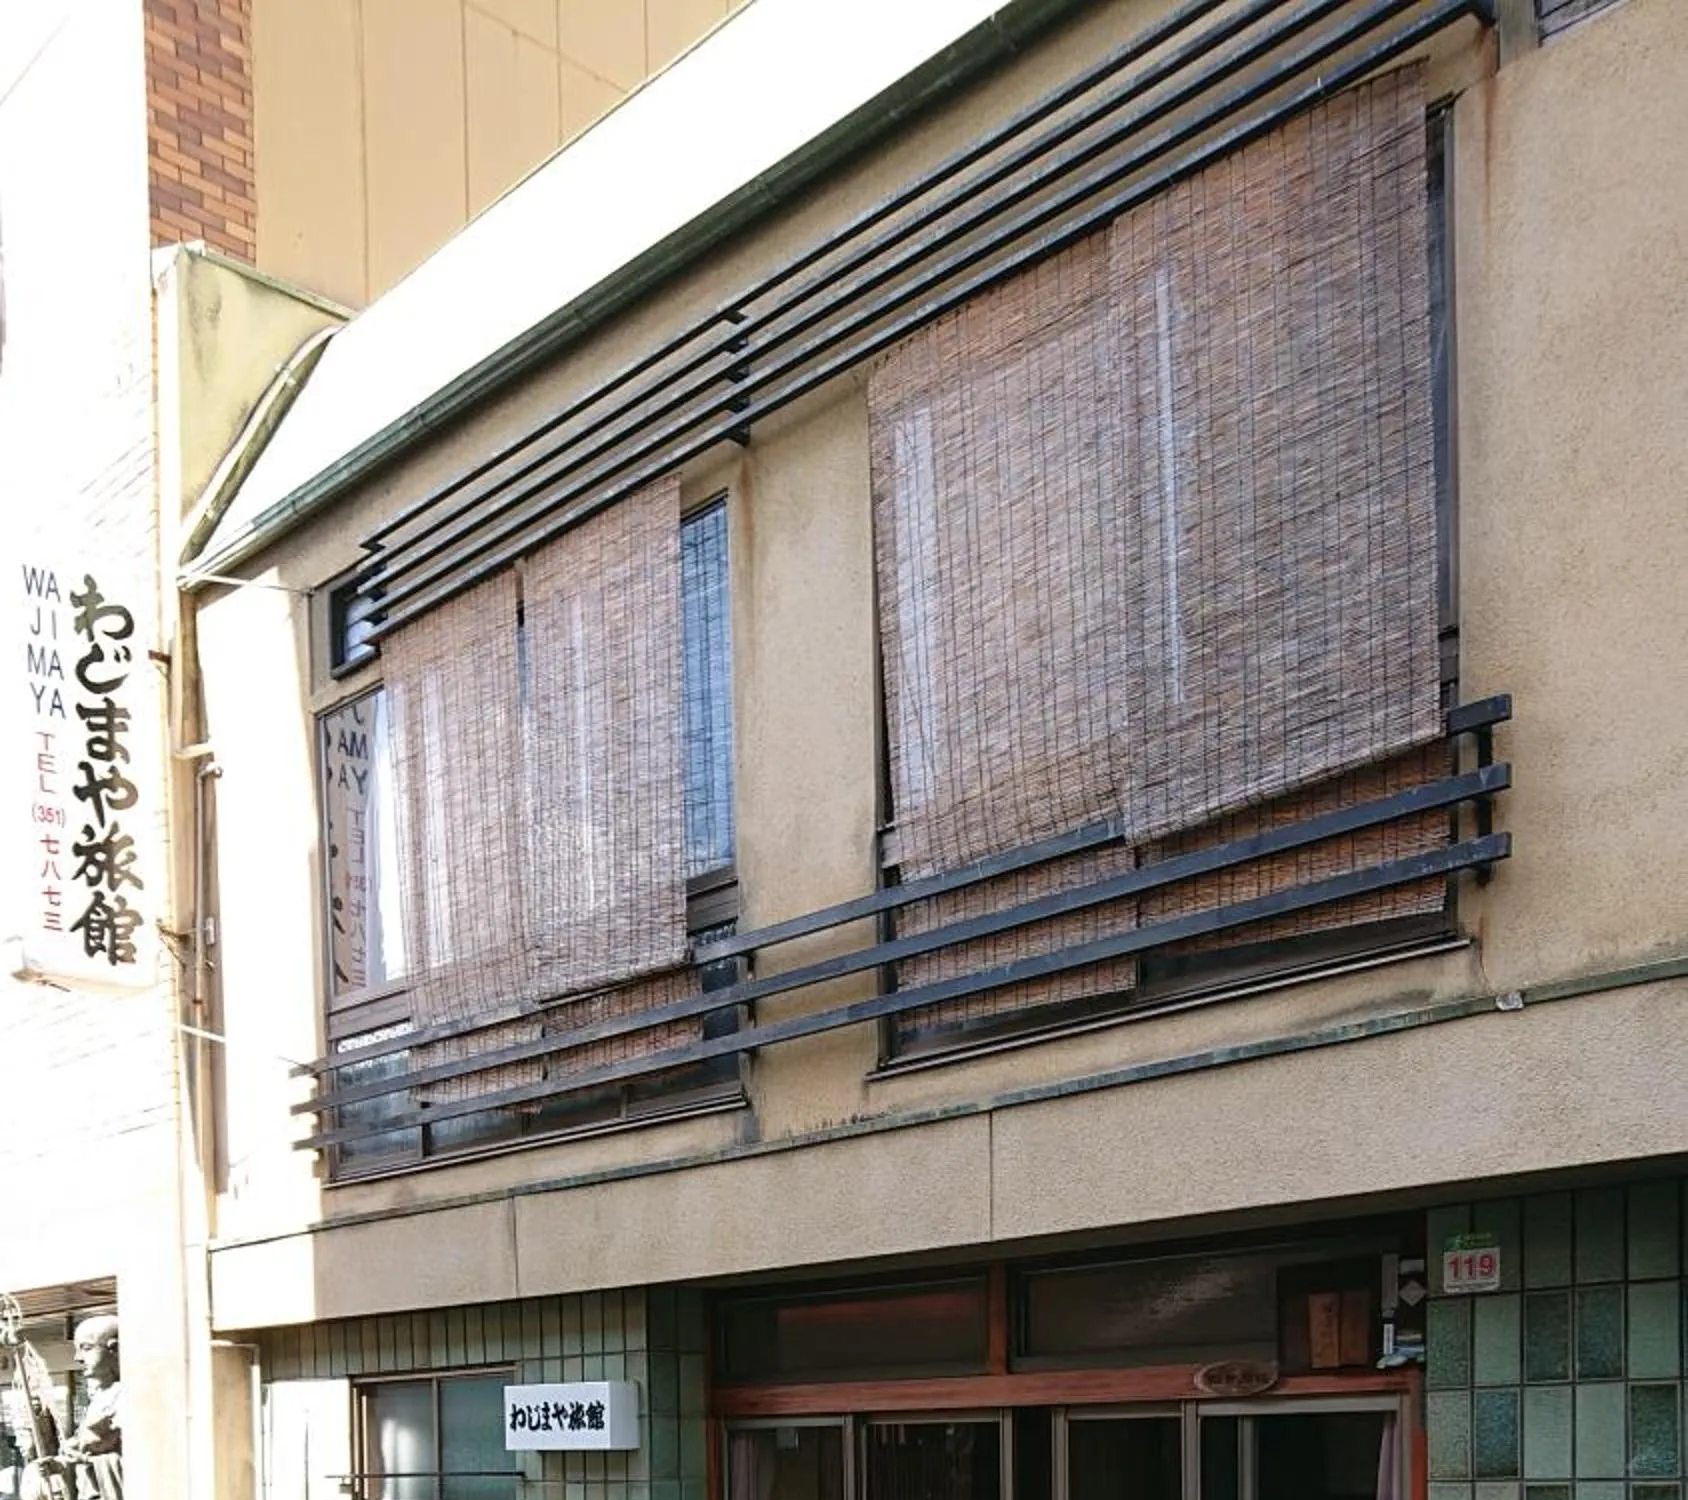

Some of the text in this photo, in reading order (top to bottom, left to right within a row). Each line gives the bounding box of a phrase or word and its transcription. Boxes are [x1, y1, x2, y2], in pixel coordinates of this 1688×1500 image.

[22, 563, 61, 603] WA
[30, 606, 57, 641] JI
[27, 642, 64, 681] MA
[30, 681, 66, 720] YA
[36, 732, 57, 794] TEL
[70, 573, 144, 966] わじまや旅館
[39, 833, 63, 932] 七八七三
[1448, 1253, 1496, 1281] 119
[509, 1400, 606, 1432] わじまや旅館
